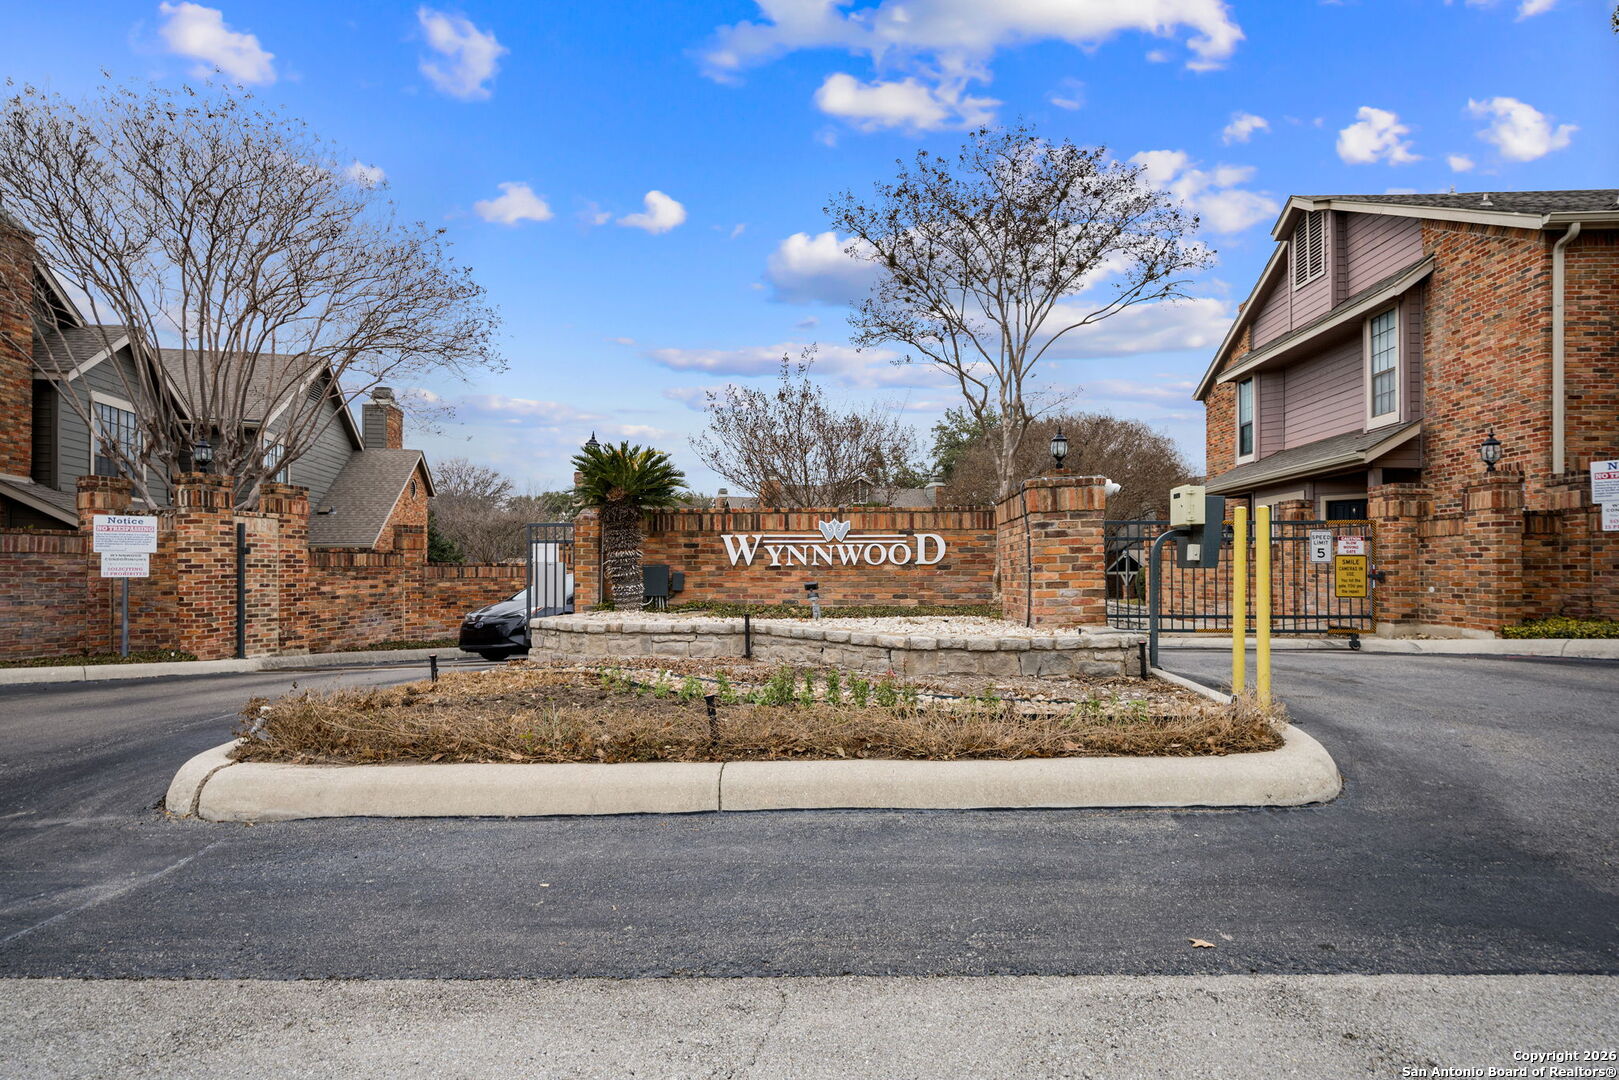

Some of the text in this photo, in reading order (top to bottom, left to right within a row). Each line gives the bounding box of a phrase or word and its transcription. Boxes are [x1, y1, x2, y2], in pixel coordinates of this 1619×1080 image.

[107, 516, 144, 524] Notice
[720, 533, 946, 566] WYNNWOOD
[1317, 548, 1325, 558] 5
